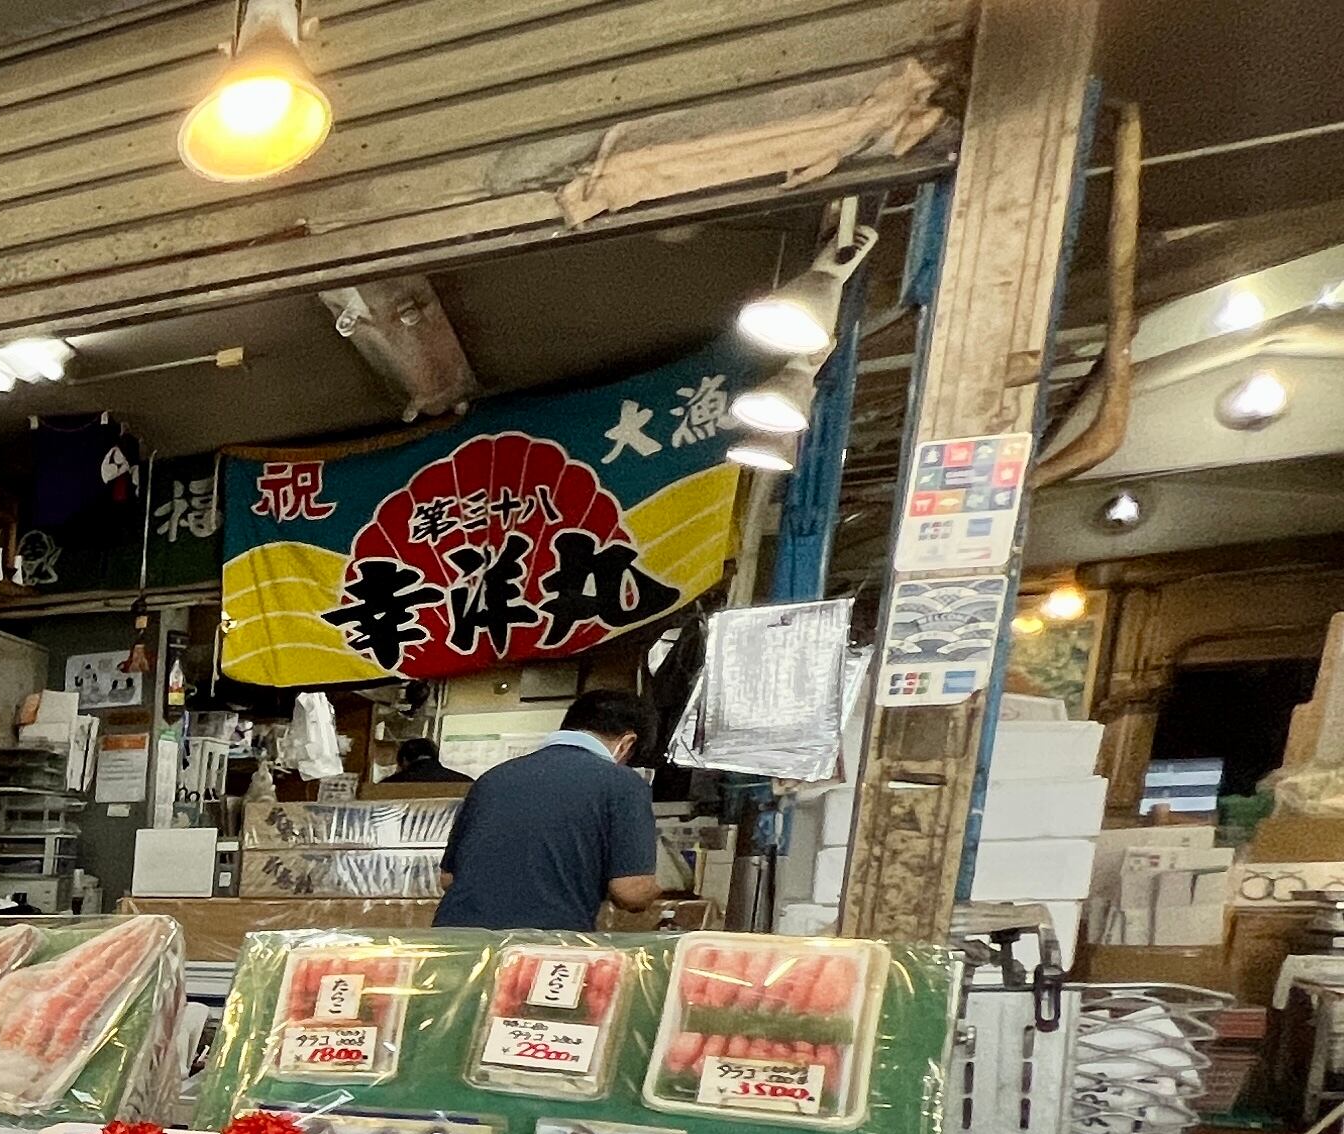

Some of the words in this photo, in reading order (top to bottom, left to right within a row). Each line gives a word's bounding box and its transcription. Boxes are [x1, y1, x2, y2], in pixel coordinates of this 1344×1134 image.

[600, 375, 737, 464] 大漁
[154, 477, 223, 542] 福
[251, 461, 336, 523] 祝
[409, 486, 563, 544] 第三十八
[321, 529, 681, 671] 幸洋丸
[328, 978, 349, 1014] たらこ
[544, 963, 570, 1001] たらこ
